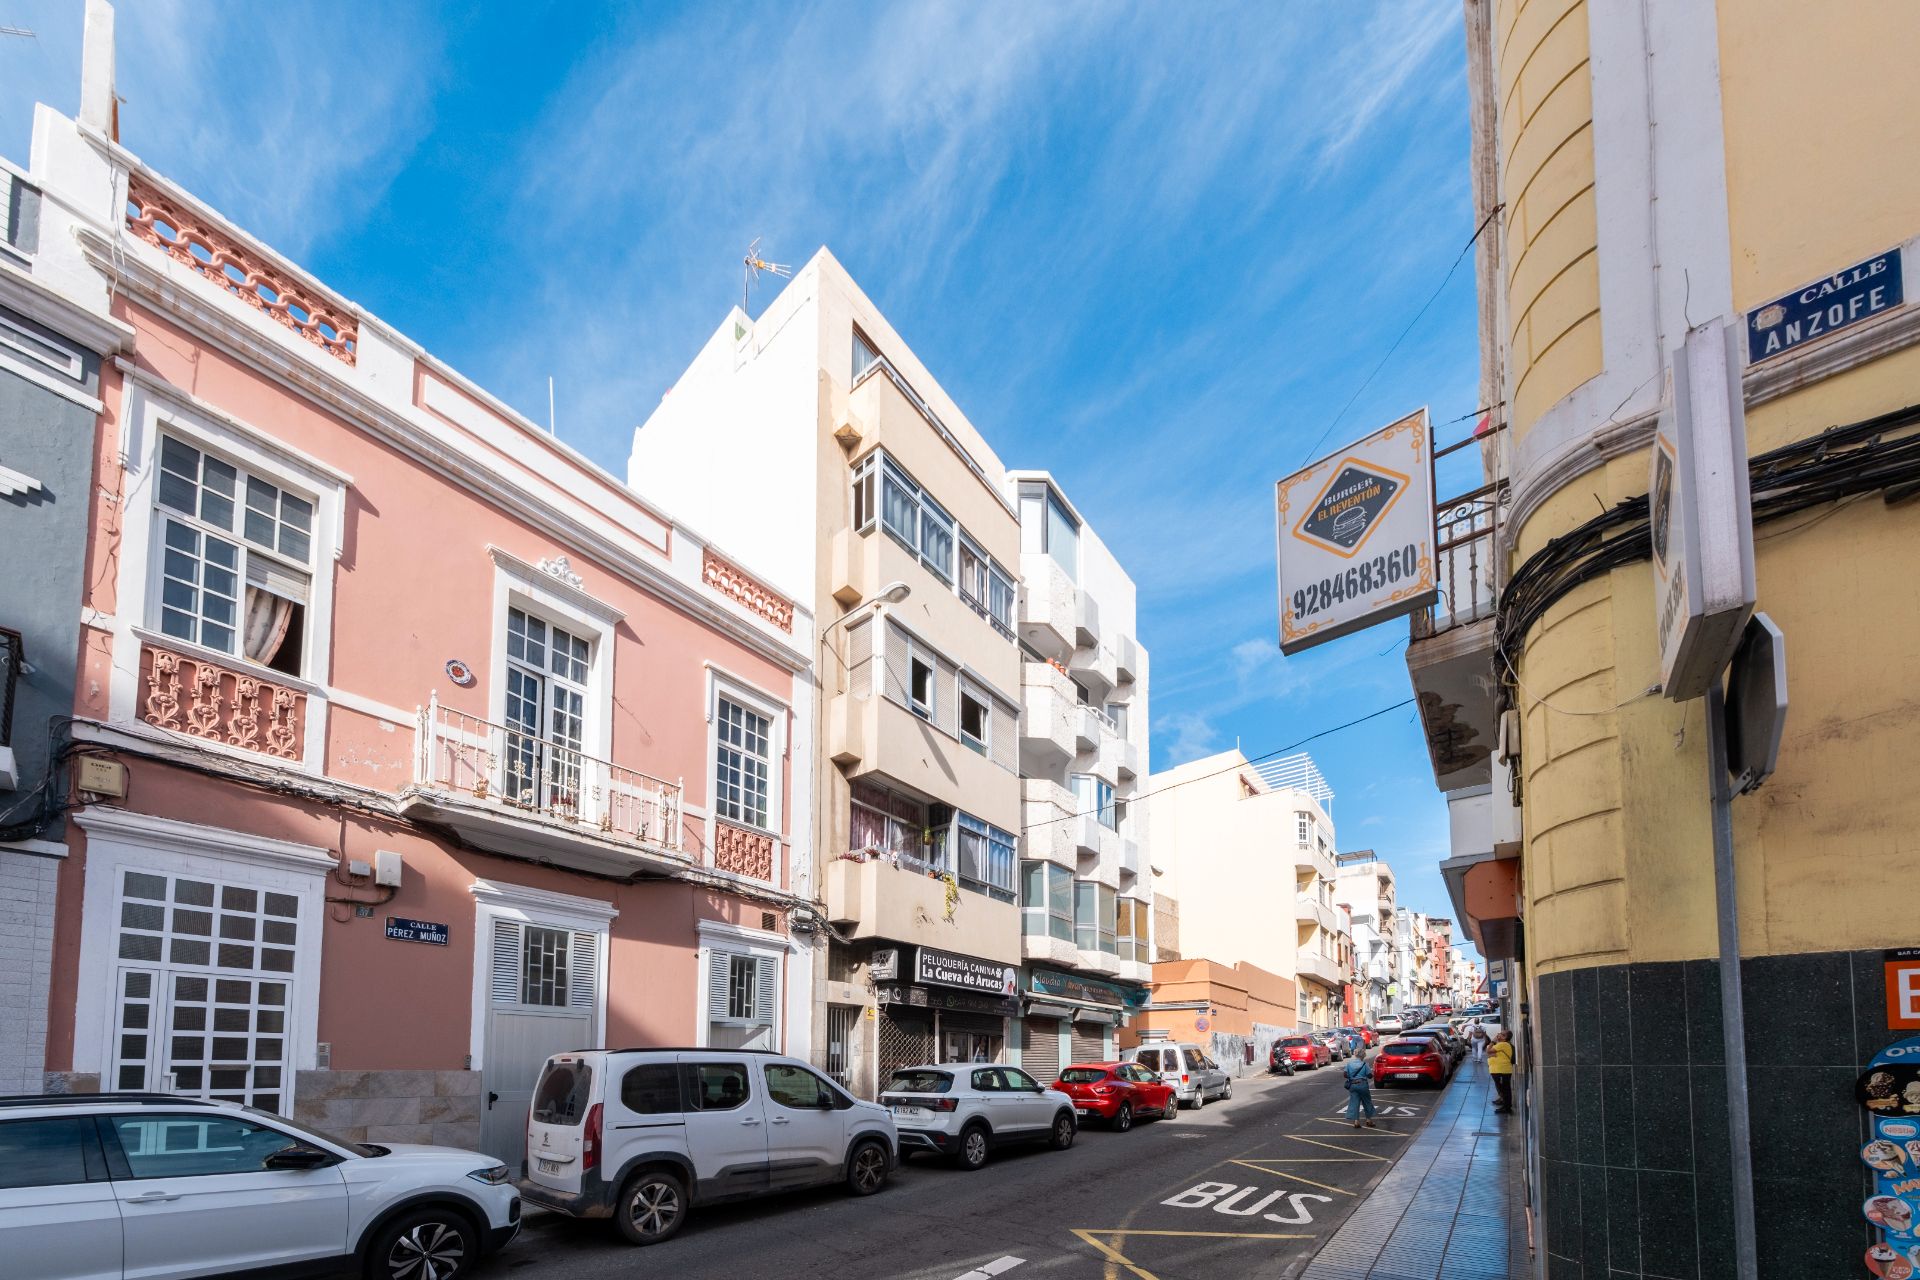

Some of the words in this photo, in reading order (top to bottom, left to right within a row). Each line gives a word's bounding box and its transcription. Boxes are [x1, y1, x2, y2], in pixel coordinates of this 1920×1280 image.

[1799, 258, 1888, 304] CALLE
[1764, 285, 1886, 354] ANZOFE
[1318, 510, 1329, 522] EL
[1329, 484, 1382, 516] REVENTÓN
[1323, 477, 1374, 507] BURGER
[1293, 543, 1417, 620] 928468360
[387, 927, 414, 939] PÉREZ
[419, 931, 447, 943] MUÑOZ
[410, 922, 437, 931] CALLE
[922, 952, 969, 971] PELUQUERÍA
[970, 963, 996, 977] CANINA
[922, 964, 934, 978] La
[935, 967, 963, 983] Cueva
[963, 972, 975, 985] de
[976, 975, 1003, 990] Arucas
[1160, 1181, 1334, 1225] BUS
